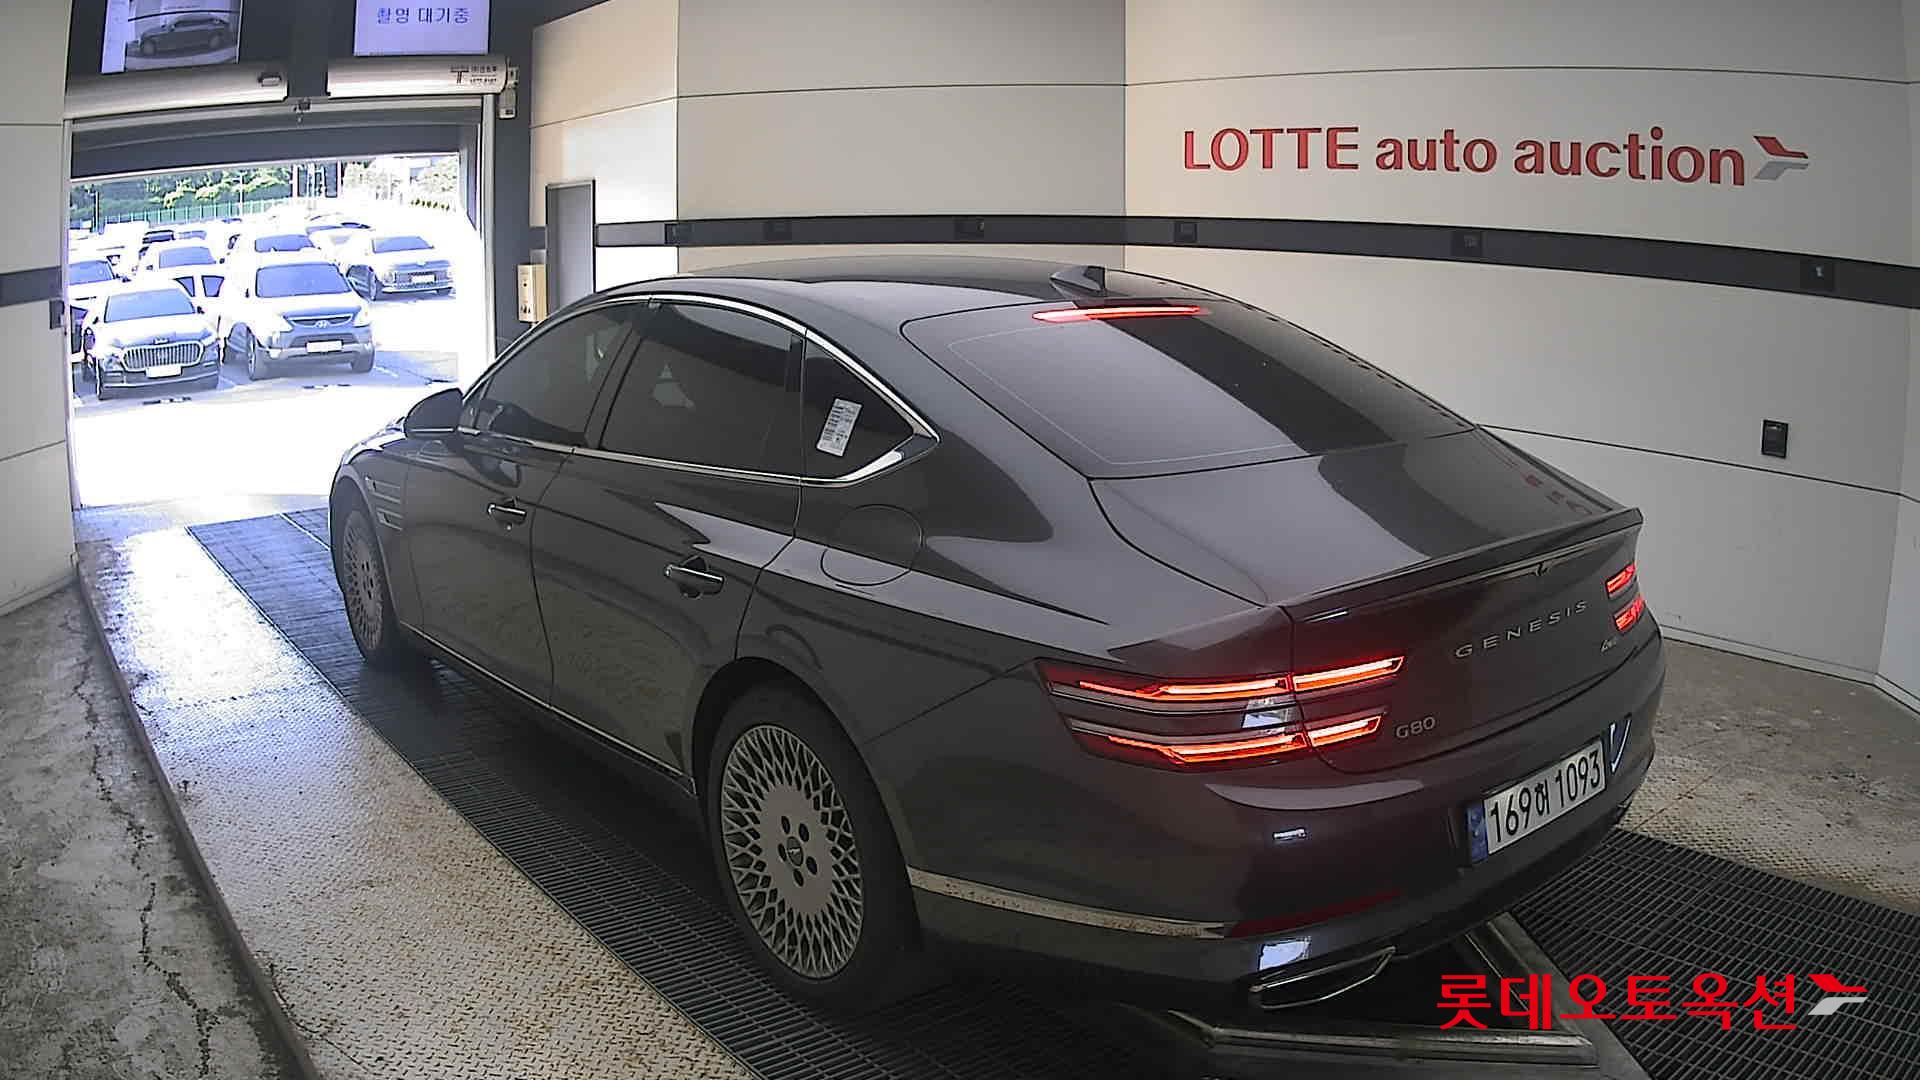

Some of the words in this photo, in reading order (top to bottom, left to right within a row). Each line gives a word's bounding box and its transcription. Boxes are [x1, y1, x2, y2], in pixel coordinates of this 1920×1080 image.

[377, 7, 409, 24] 촬영
[418, 7, 469, 24] 대기중
[1184, 127, 1359, 171] LOTTE
[1375, 128, 1497, 173] auto
[1514, 126, 1745, 187] auction
[1455, 600, 1587, 658] GENESIS
[1396, 716, 1436, 738] G80
[1555, 749, 1600, 809] 1093
